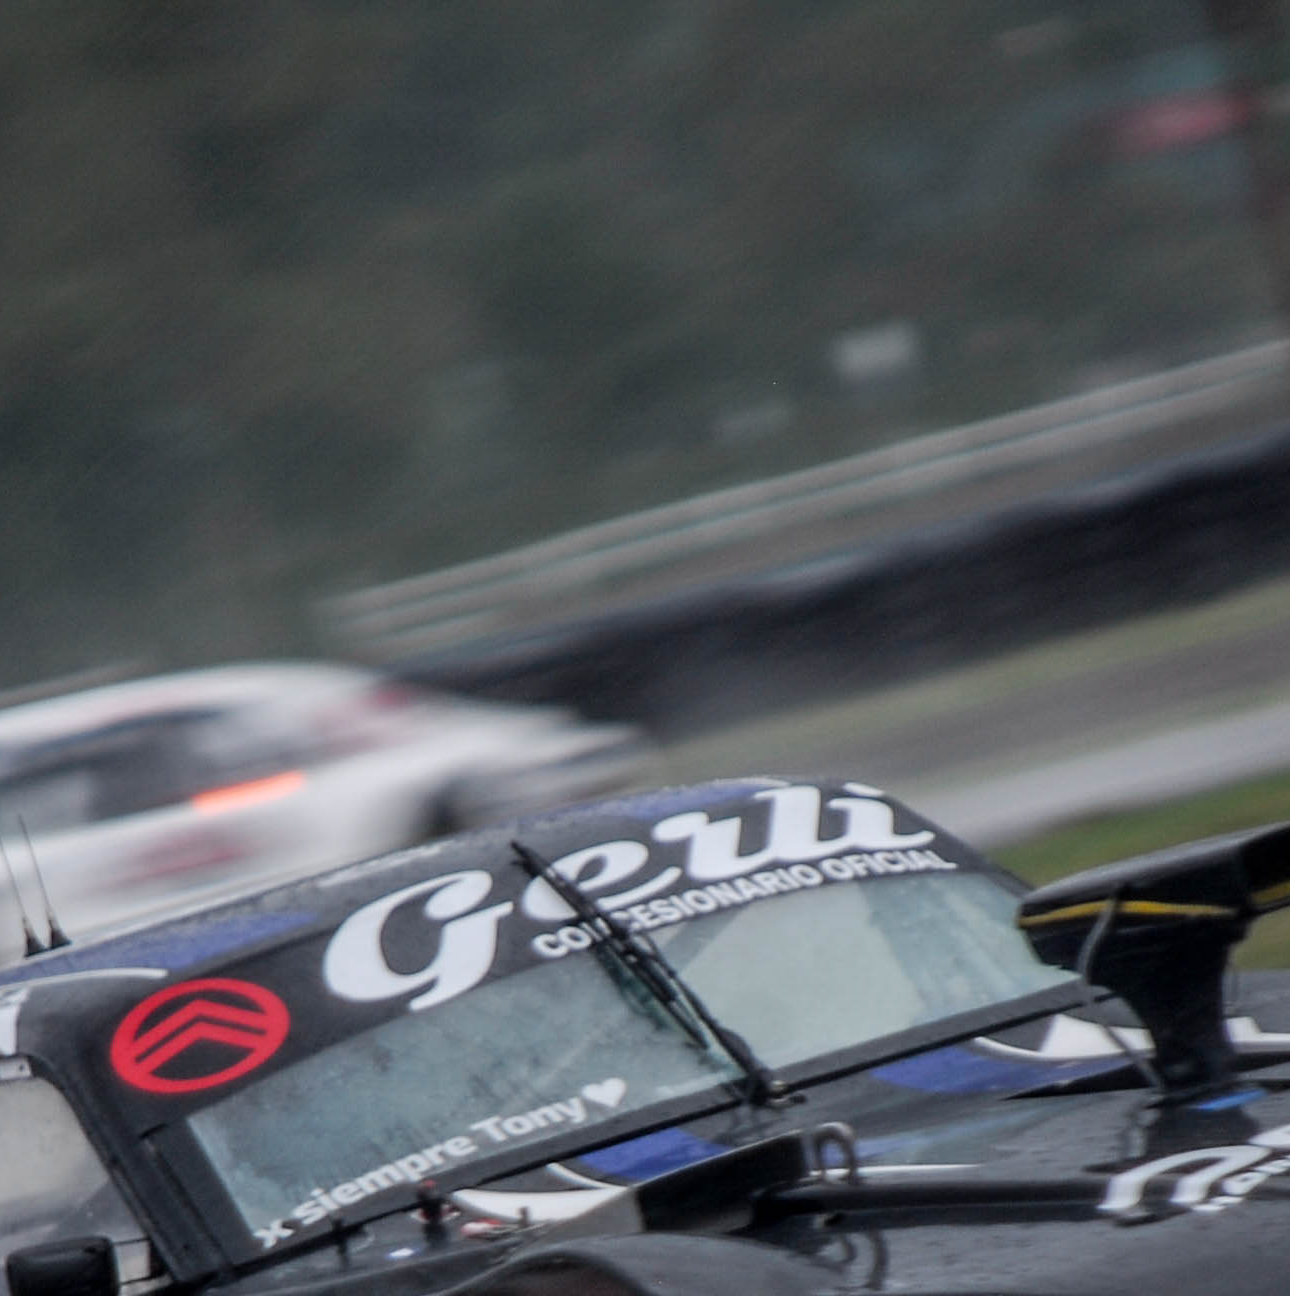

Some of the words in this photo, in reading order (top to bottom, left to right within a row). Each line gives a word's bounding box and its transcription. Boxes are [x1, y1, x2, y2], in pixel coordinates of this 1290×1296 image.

[322, 782, 936, 1010] Gerli
[820, 850, 958, 881] OFICIAL
[292, 1135, 479, 1226] siempre
[470, 1097, 587, 1143] Tony
